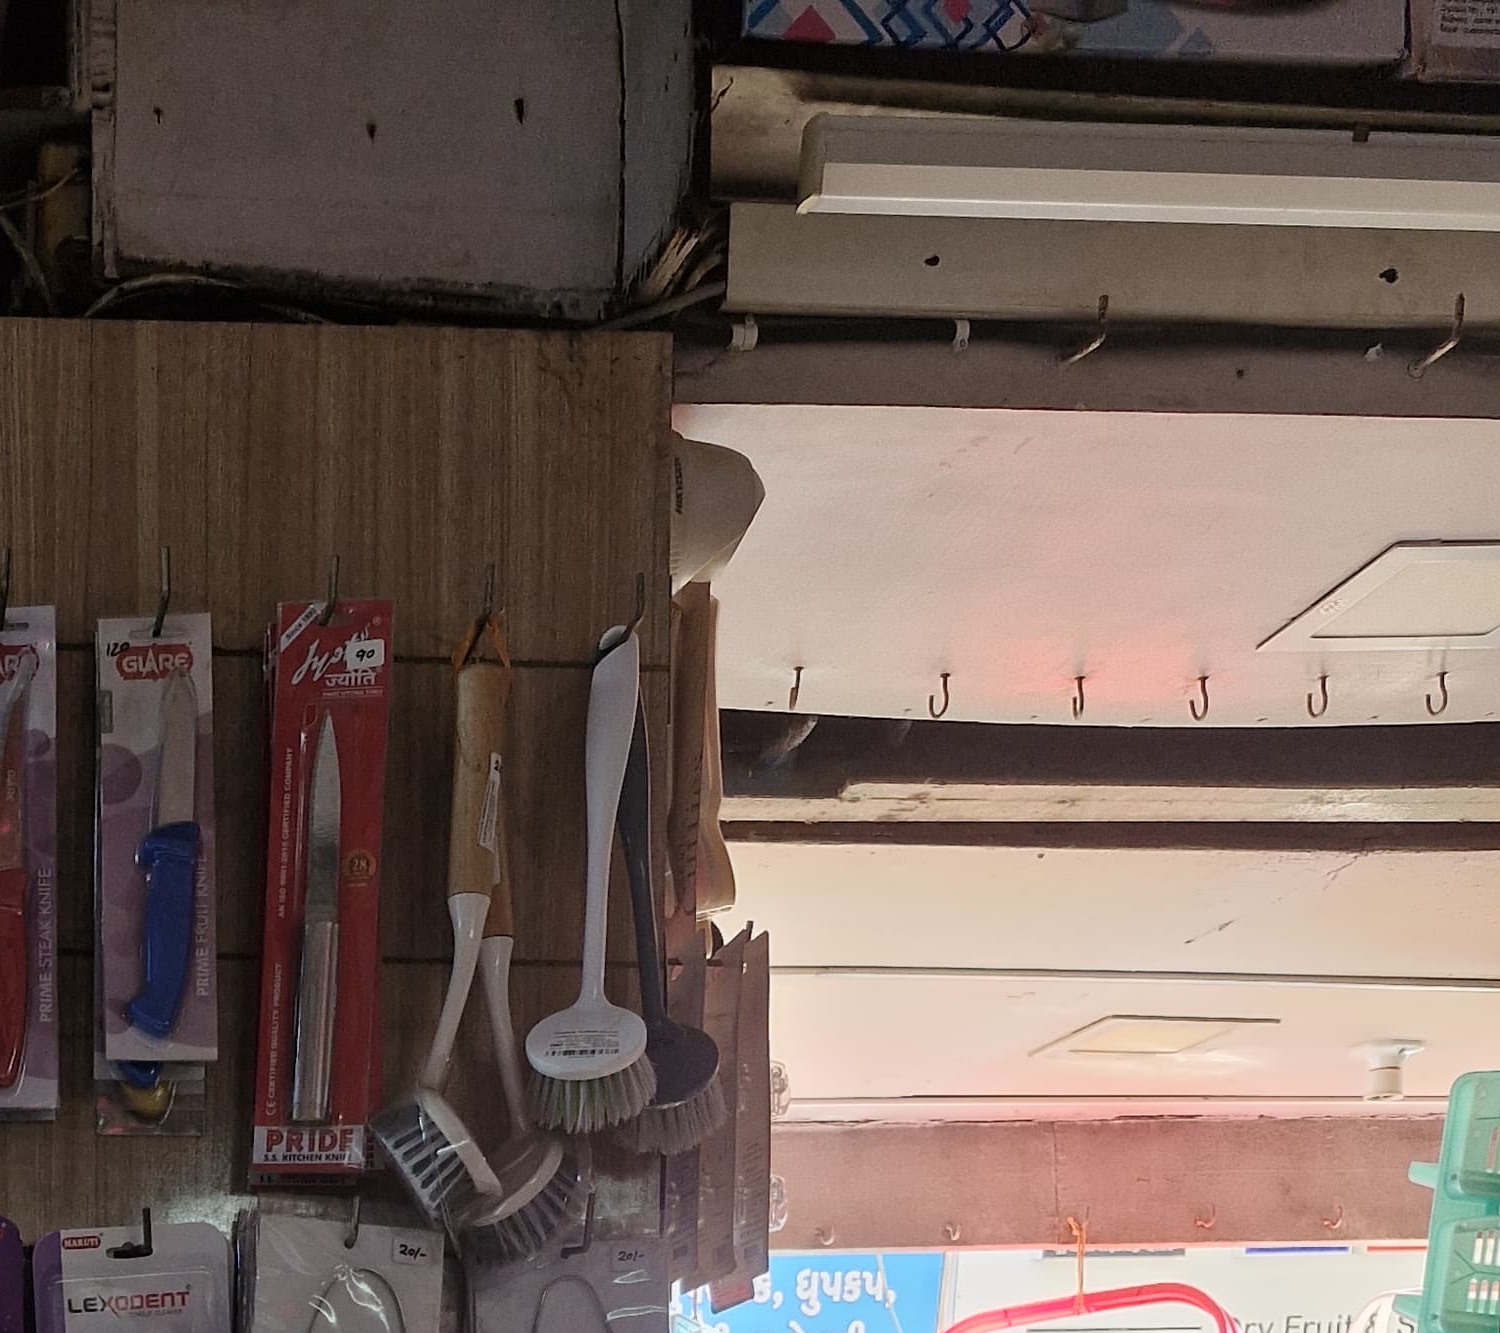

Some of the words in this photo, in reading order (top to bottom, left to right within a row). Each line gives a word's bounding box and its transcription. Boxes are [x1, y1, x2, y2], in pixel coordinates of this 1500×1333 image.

[107, 643, 129, 656] 120
[123, 647, 189, 675] GLARE
[356, 649, 375, 661] 90
[38, 867, 52, 915] KNIFE
[195, 902, 209, 946] FRUIT
[39, 919, 52, 969] STEAK
[196, 948, 210, 995] PRIME
[40, 974, 53, 1023] PRIME
[266, 1129, 353, 1152] PRIDE
[282, 1153, 322, 1162] KITCHEN
[64, 1237, 99, 1248] MARUTI
[399, 1244, 427, 1257] 20/-
[67, 1291, 190, 1314] LEXODENT
